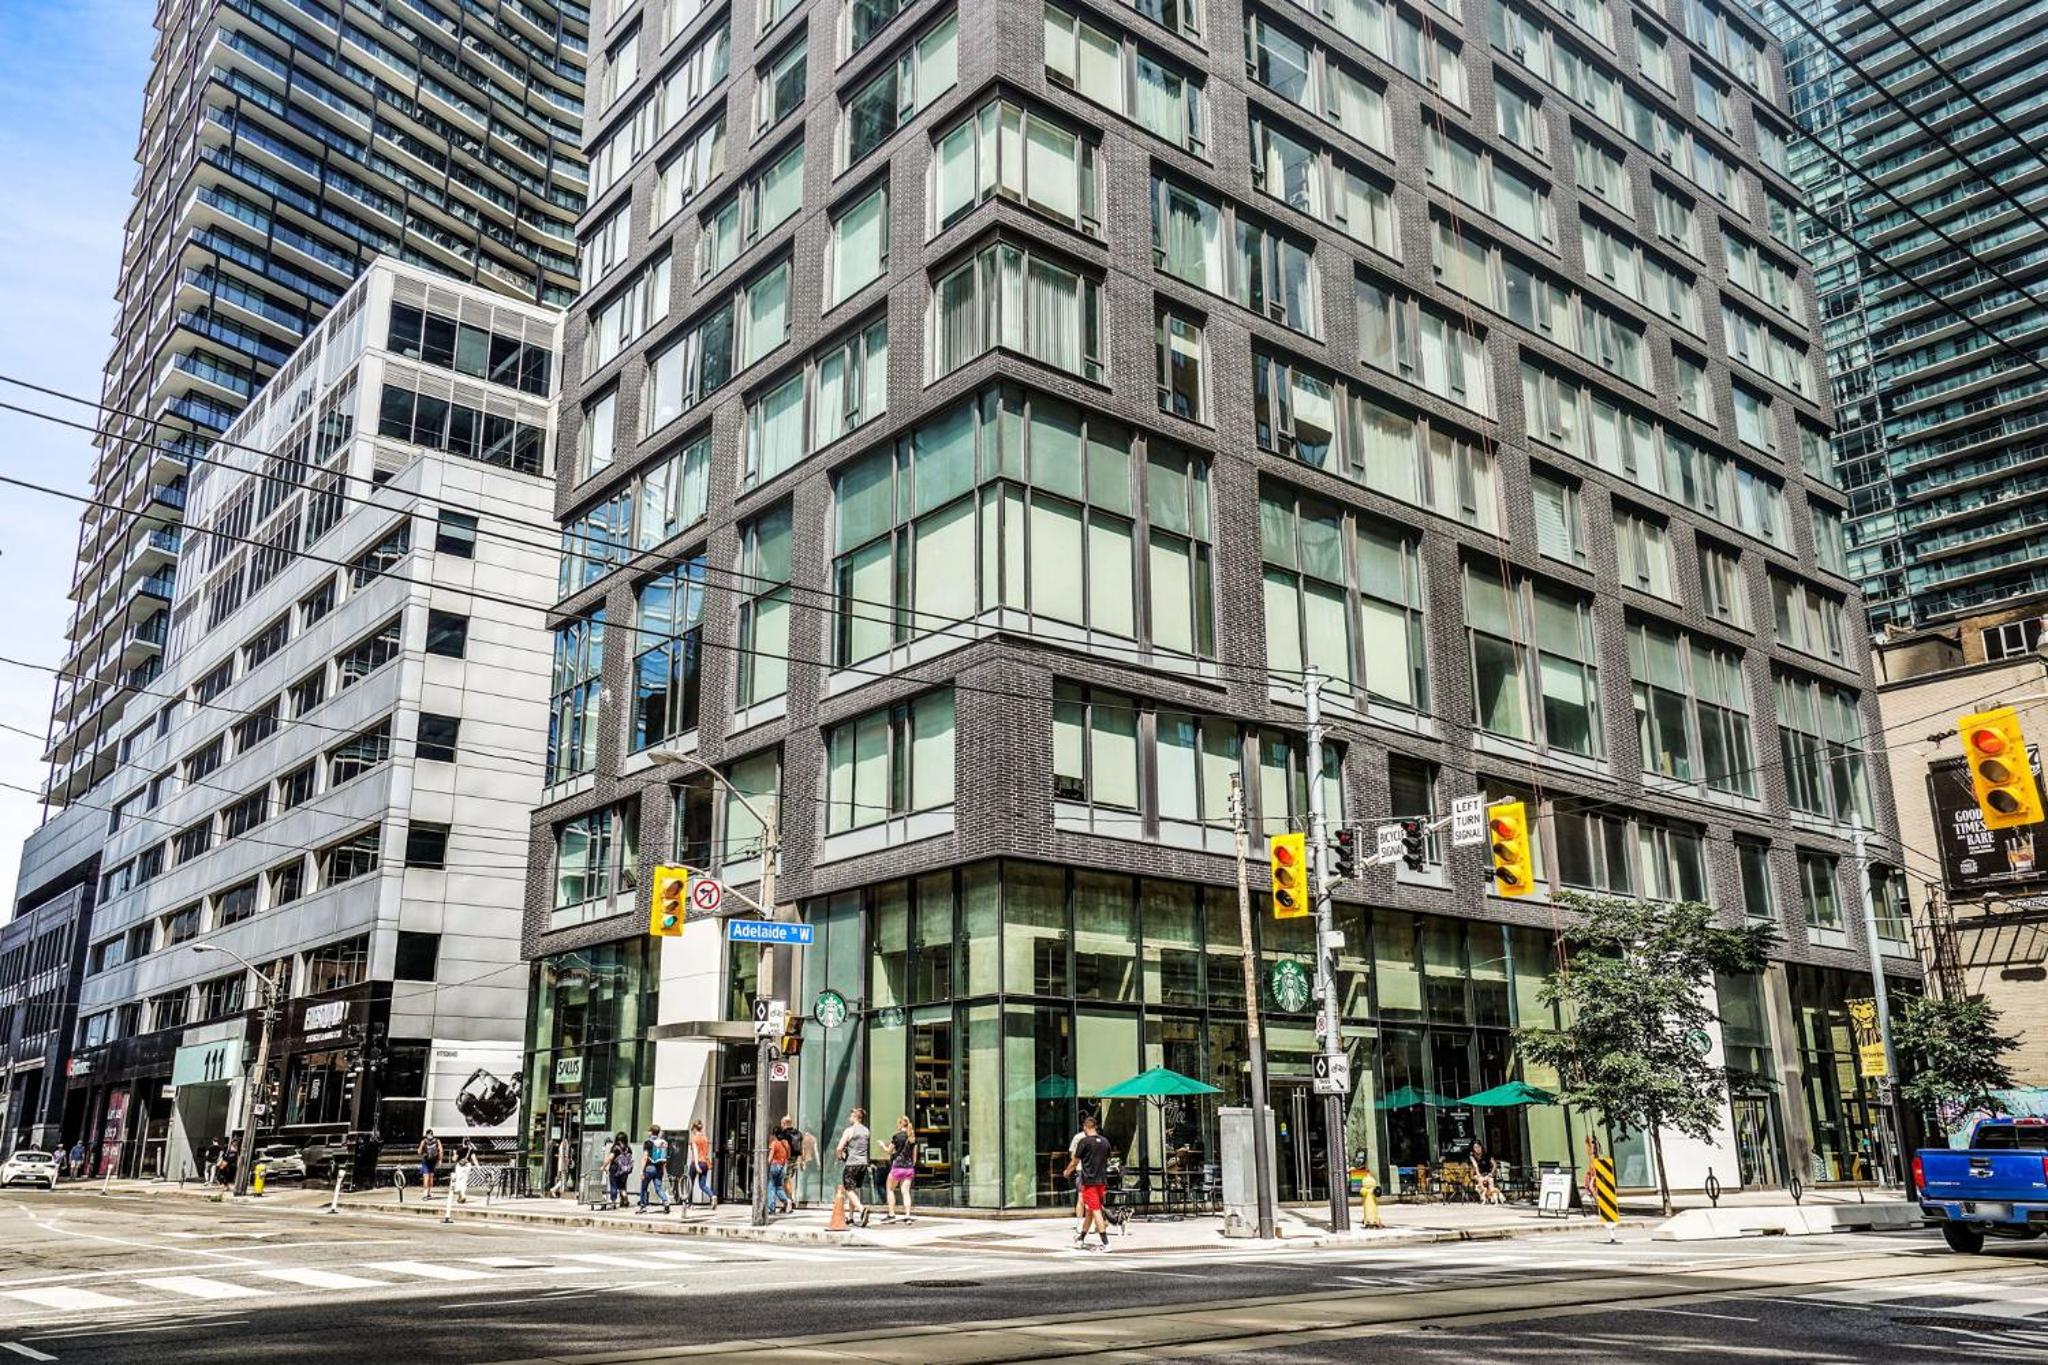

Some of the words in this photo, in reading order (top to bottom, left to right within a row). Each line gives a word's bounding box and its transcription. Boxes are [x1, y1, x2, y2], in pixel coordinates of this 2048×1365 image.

[1456, 800, 1479, 813] LEFT
[1456, 814, 1481, 827] TURN
[1955, 809, 1983, 822] GOOD
[1952, 820, 1987, 834] TIMES
[1380, 830, 1405, 844] BICYCLE
[1455, 829, 1481, 840] SIGNAL
[1966, 831, 1995, 845] RARE
[733, 924, 787, 939] Adelaide
[800, 928, 809, 940] W
[204, 1047, 225, 1081] 111
[557, 1059, 580, 1075] SALUS
[740, 1063, 751, 1075] 101
